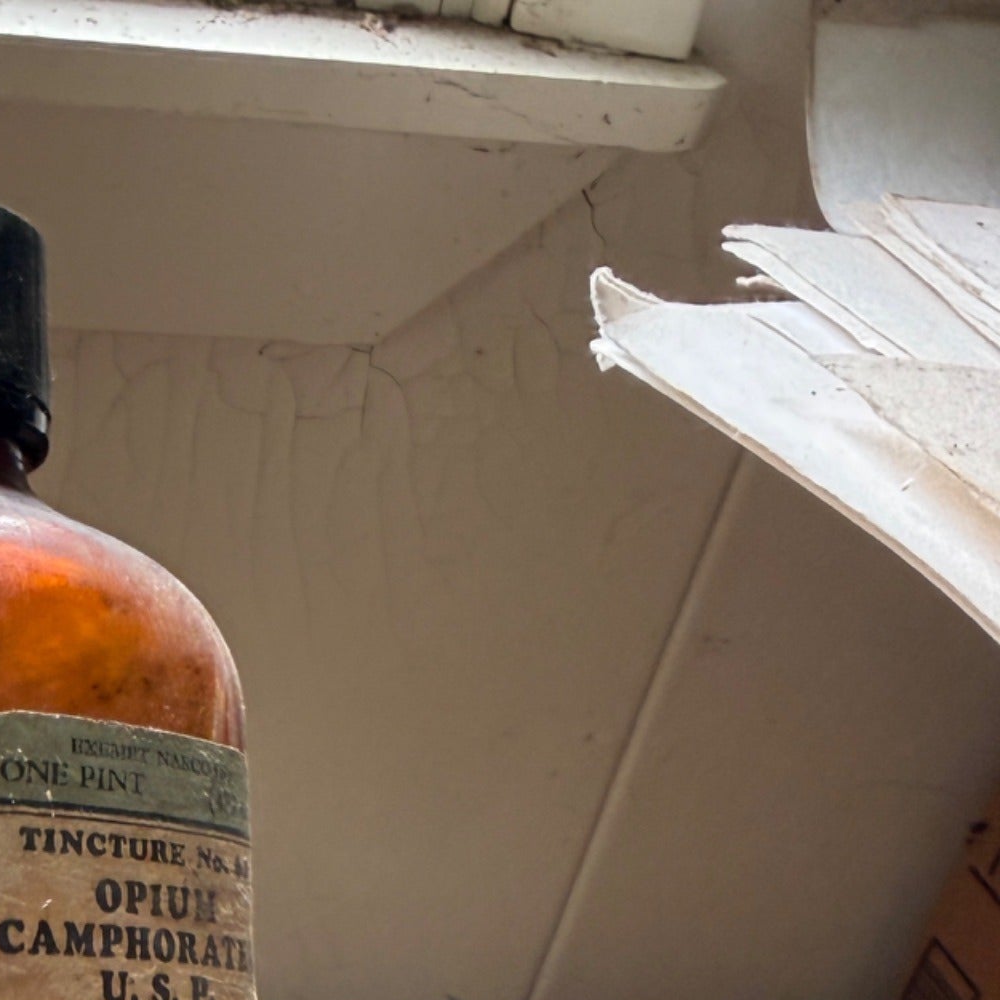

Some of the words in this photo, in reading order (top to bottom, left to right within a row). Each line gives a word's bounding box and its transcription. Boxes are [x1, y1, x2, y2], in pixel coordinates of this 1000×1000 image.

[0, 758, 69, 787] ONE
[80, 765, 146, 796] PINT
[20, 825, 186, 868] TINCTURE
